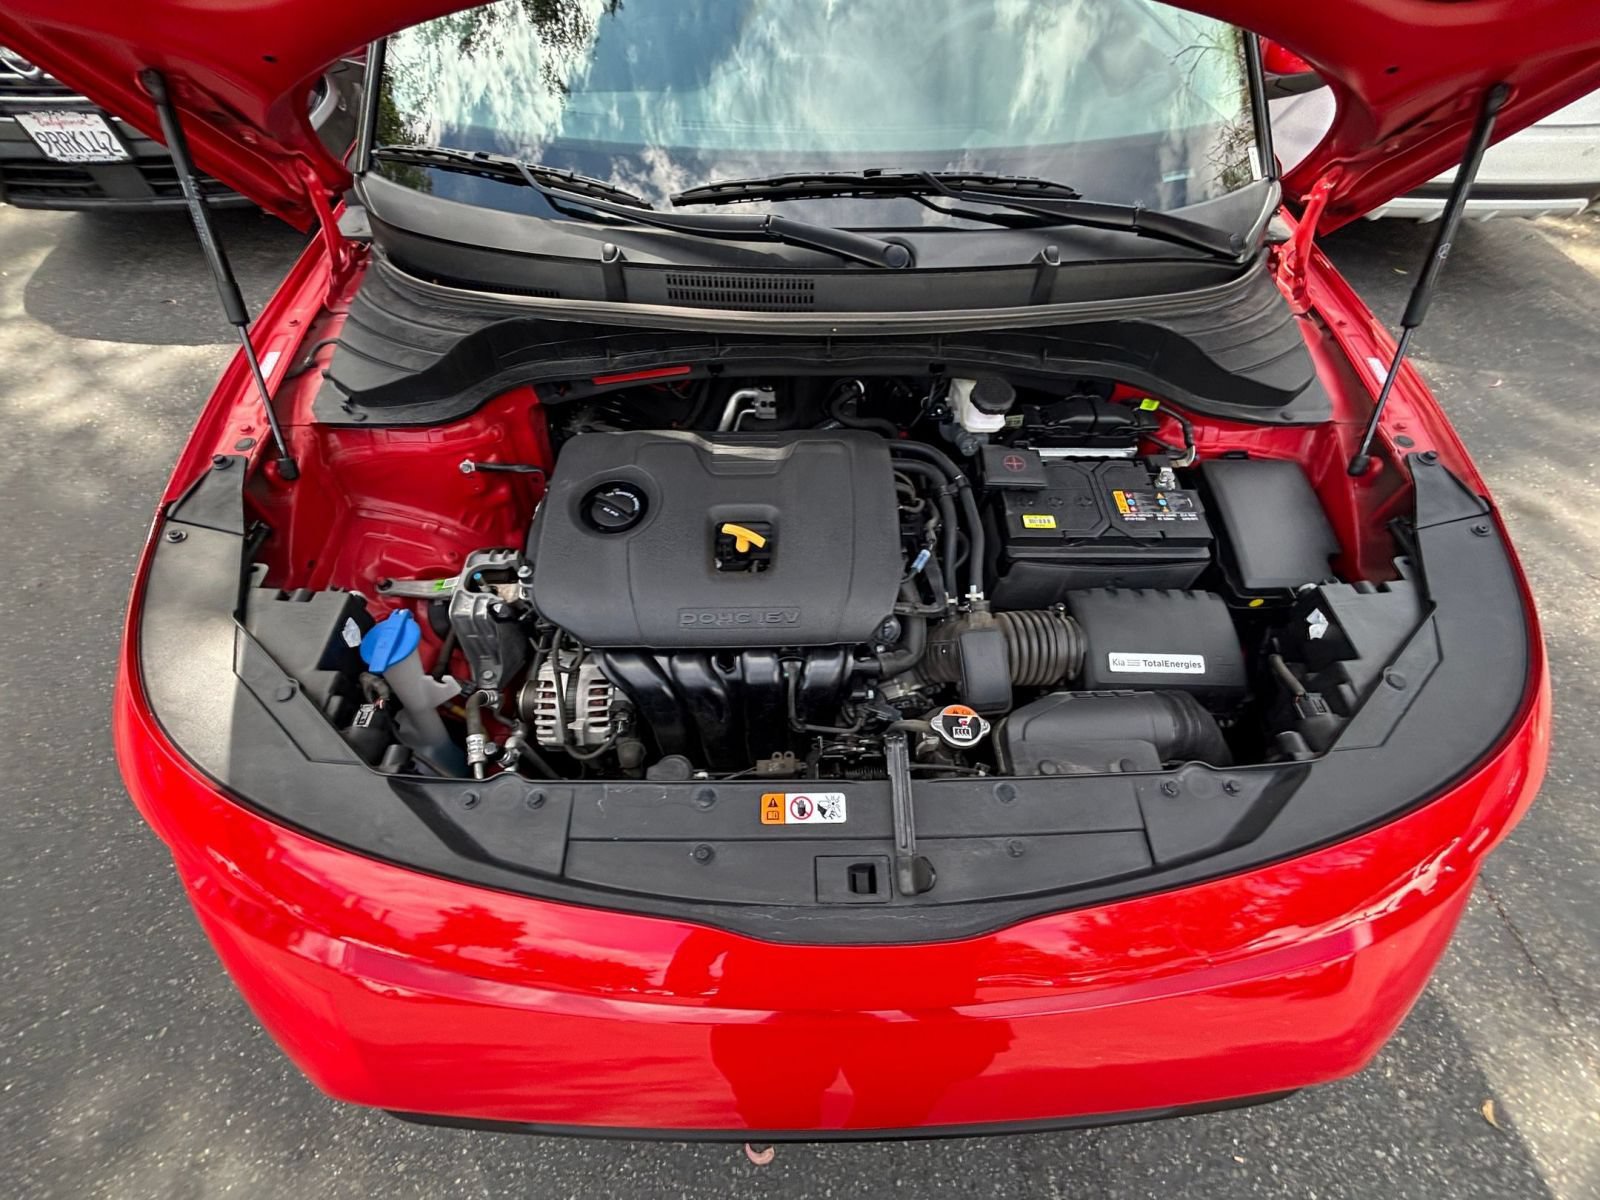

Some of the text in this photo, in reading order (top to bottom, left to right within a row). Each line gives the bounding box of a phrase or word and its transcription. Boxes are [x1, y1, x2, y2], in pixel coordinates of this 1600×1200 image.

[35, 131, 122, 156] 9RRK142
[1112, 658, 1202, 669] Kia TotalEnergies
